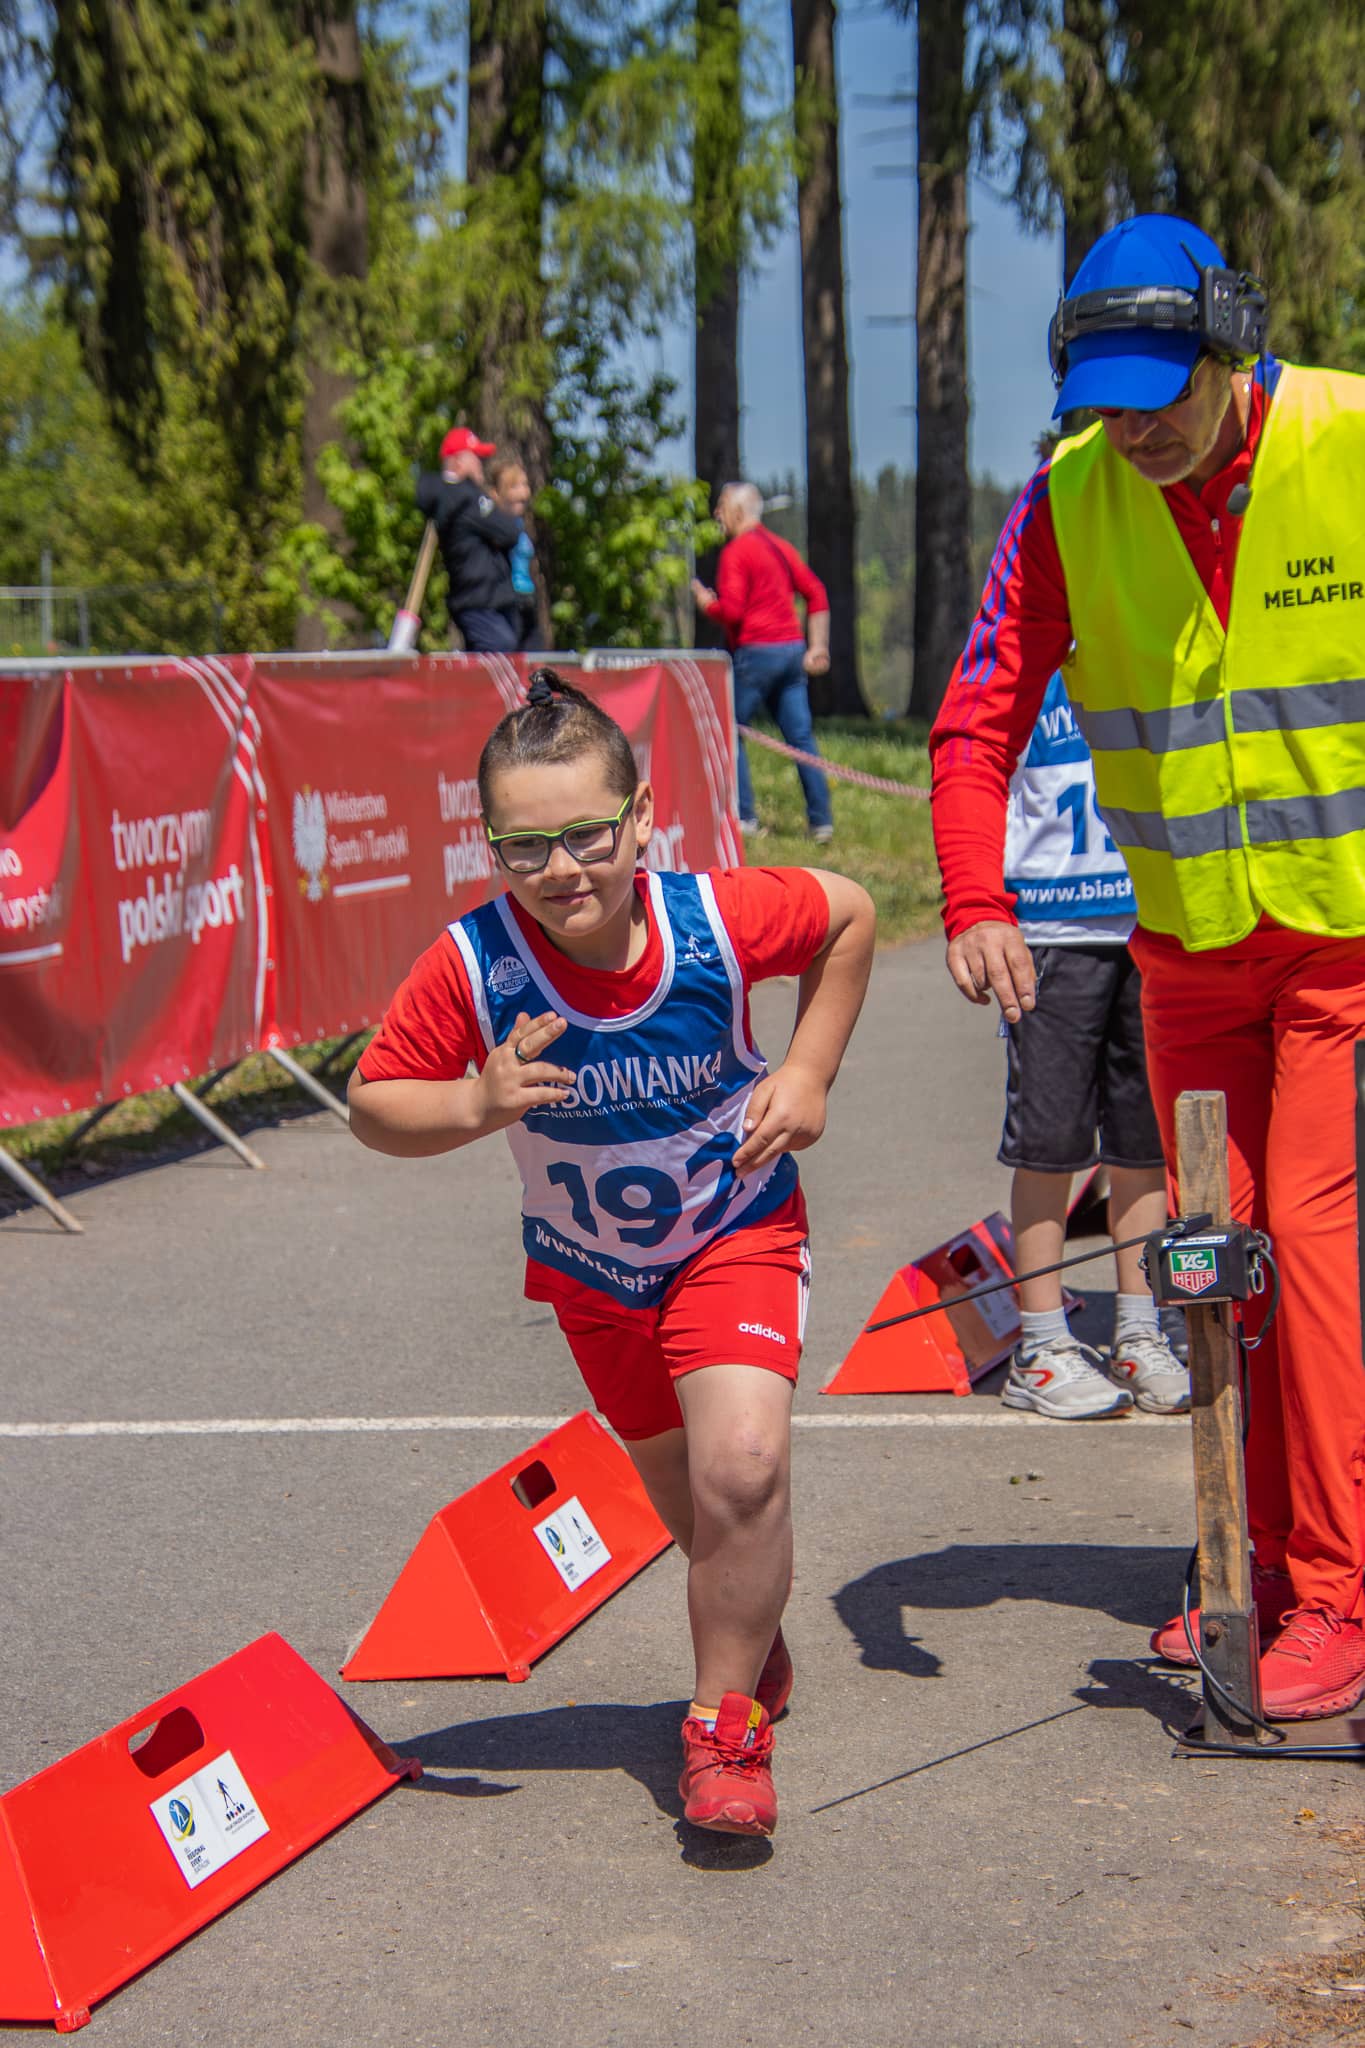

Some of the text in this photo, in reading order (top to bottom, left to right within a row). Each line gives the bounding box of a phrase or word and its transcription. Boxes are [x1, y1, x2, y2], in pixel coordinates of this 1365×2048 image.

[1287, 555, 1335, 578] UKN
[1264, 581, 1365, 609] MELAFIR
[1039, 704, 1078, 740] WY
[438, 771, 483, 823] tworz
[1057, 781, 1112, 856] 1
[118, 871, 183, 964] polski
[532, 1050, 722, 1110] SOWIANKA
[610, 1101, 645, 1113] WODA
[546, 1131, 746, 1249] 192
[1177, 1252, 1209, 1271] TAG
[1175, 1271, 1214, 1292] HEUER
[738, 1322, 786, 1345] adidas
